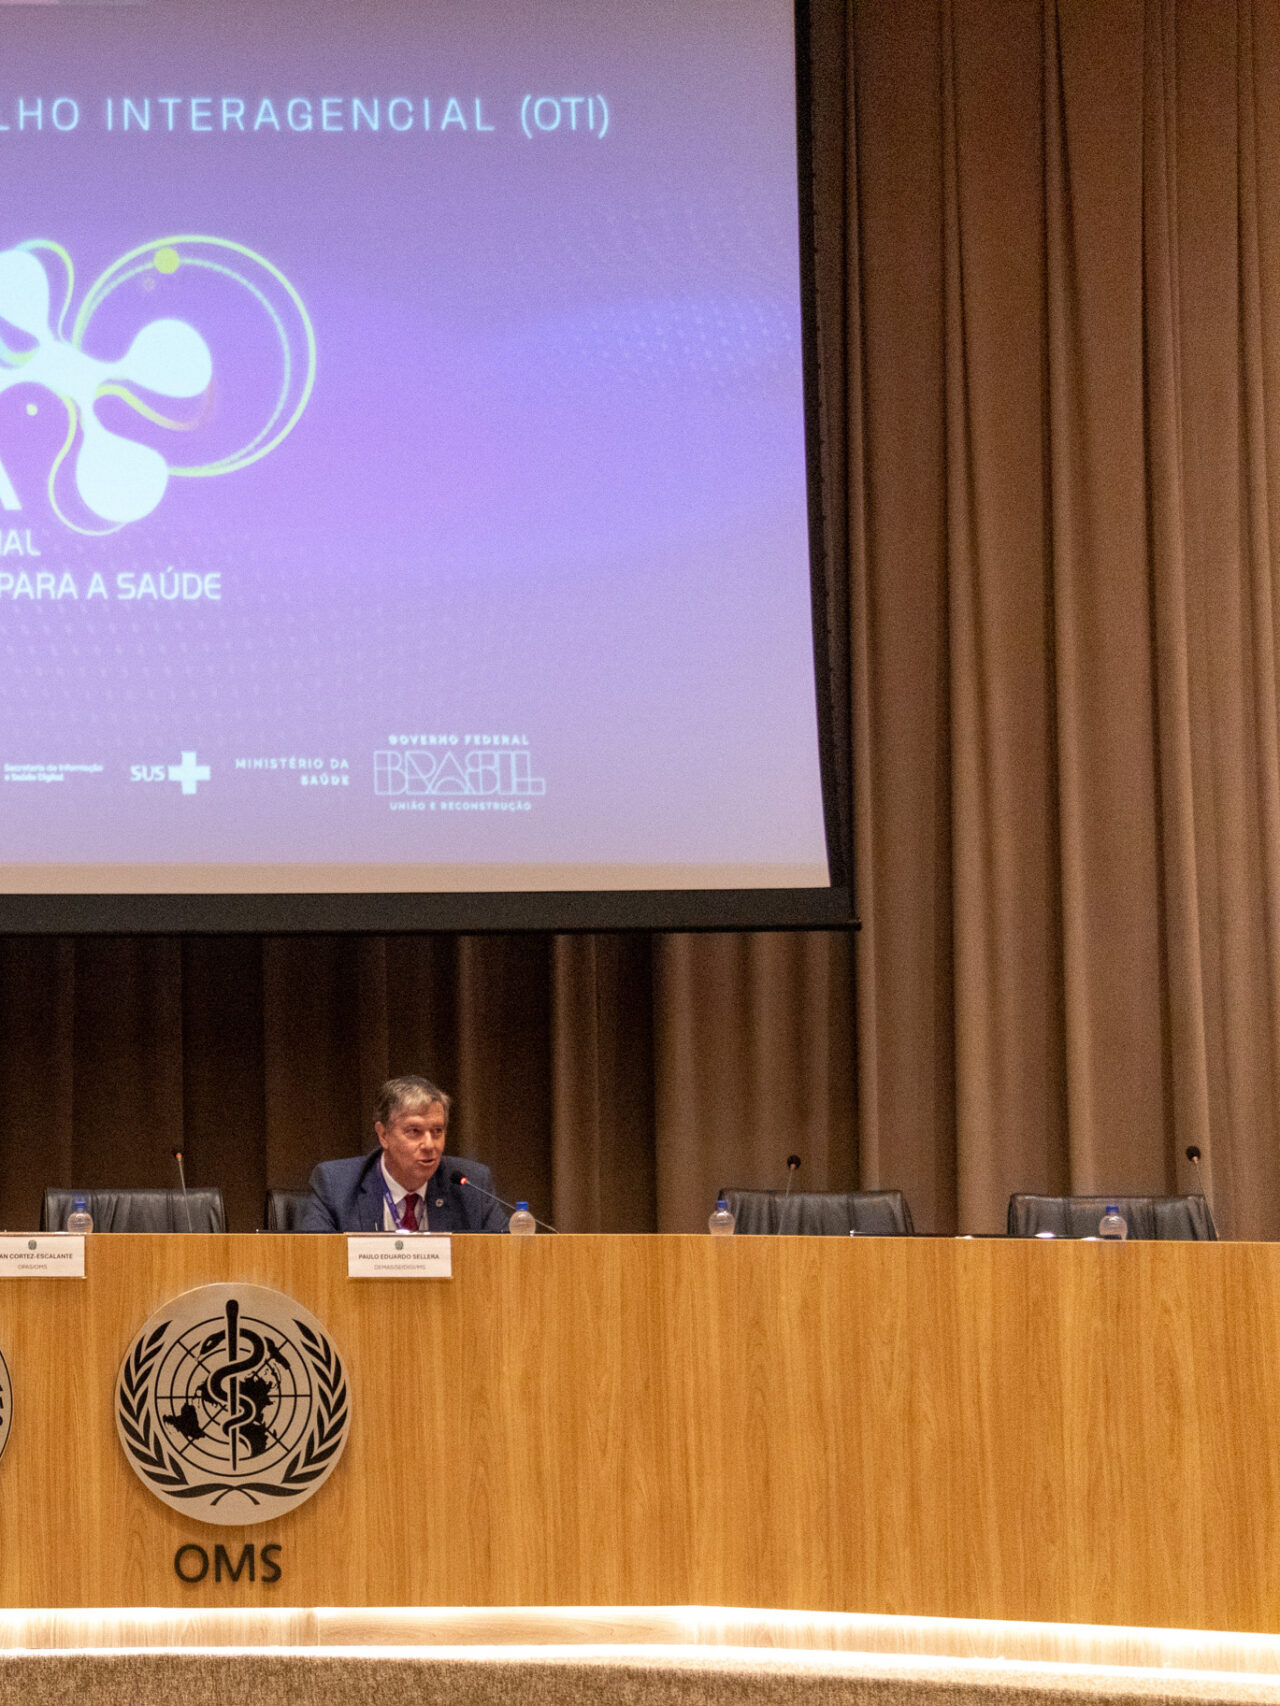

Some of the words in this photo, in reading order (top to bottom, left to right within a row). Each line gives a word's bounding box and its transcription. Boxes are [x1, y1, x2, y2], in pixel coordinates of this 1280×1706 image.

[107, 98, 495, 131] INTERAGENCIAL
[520, 95, 609, 139] (OTI)
[87, 573, 108, 599] A
[117, 566, 222, 600] SAÚDE
[388, 735, 459, 745] GOVERNO
[464, 734, 529, 745] FEDERAL
[235, 756, 323, 770] MINISTÉRIO
[330, 758, 349, 770] DA
[130, 765, 165, 781] SUS
[300, 774, 350, 786] SAÚDE
[173, 1543, 282, 1583] OMS
